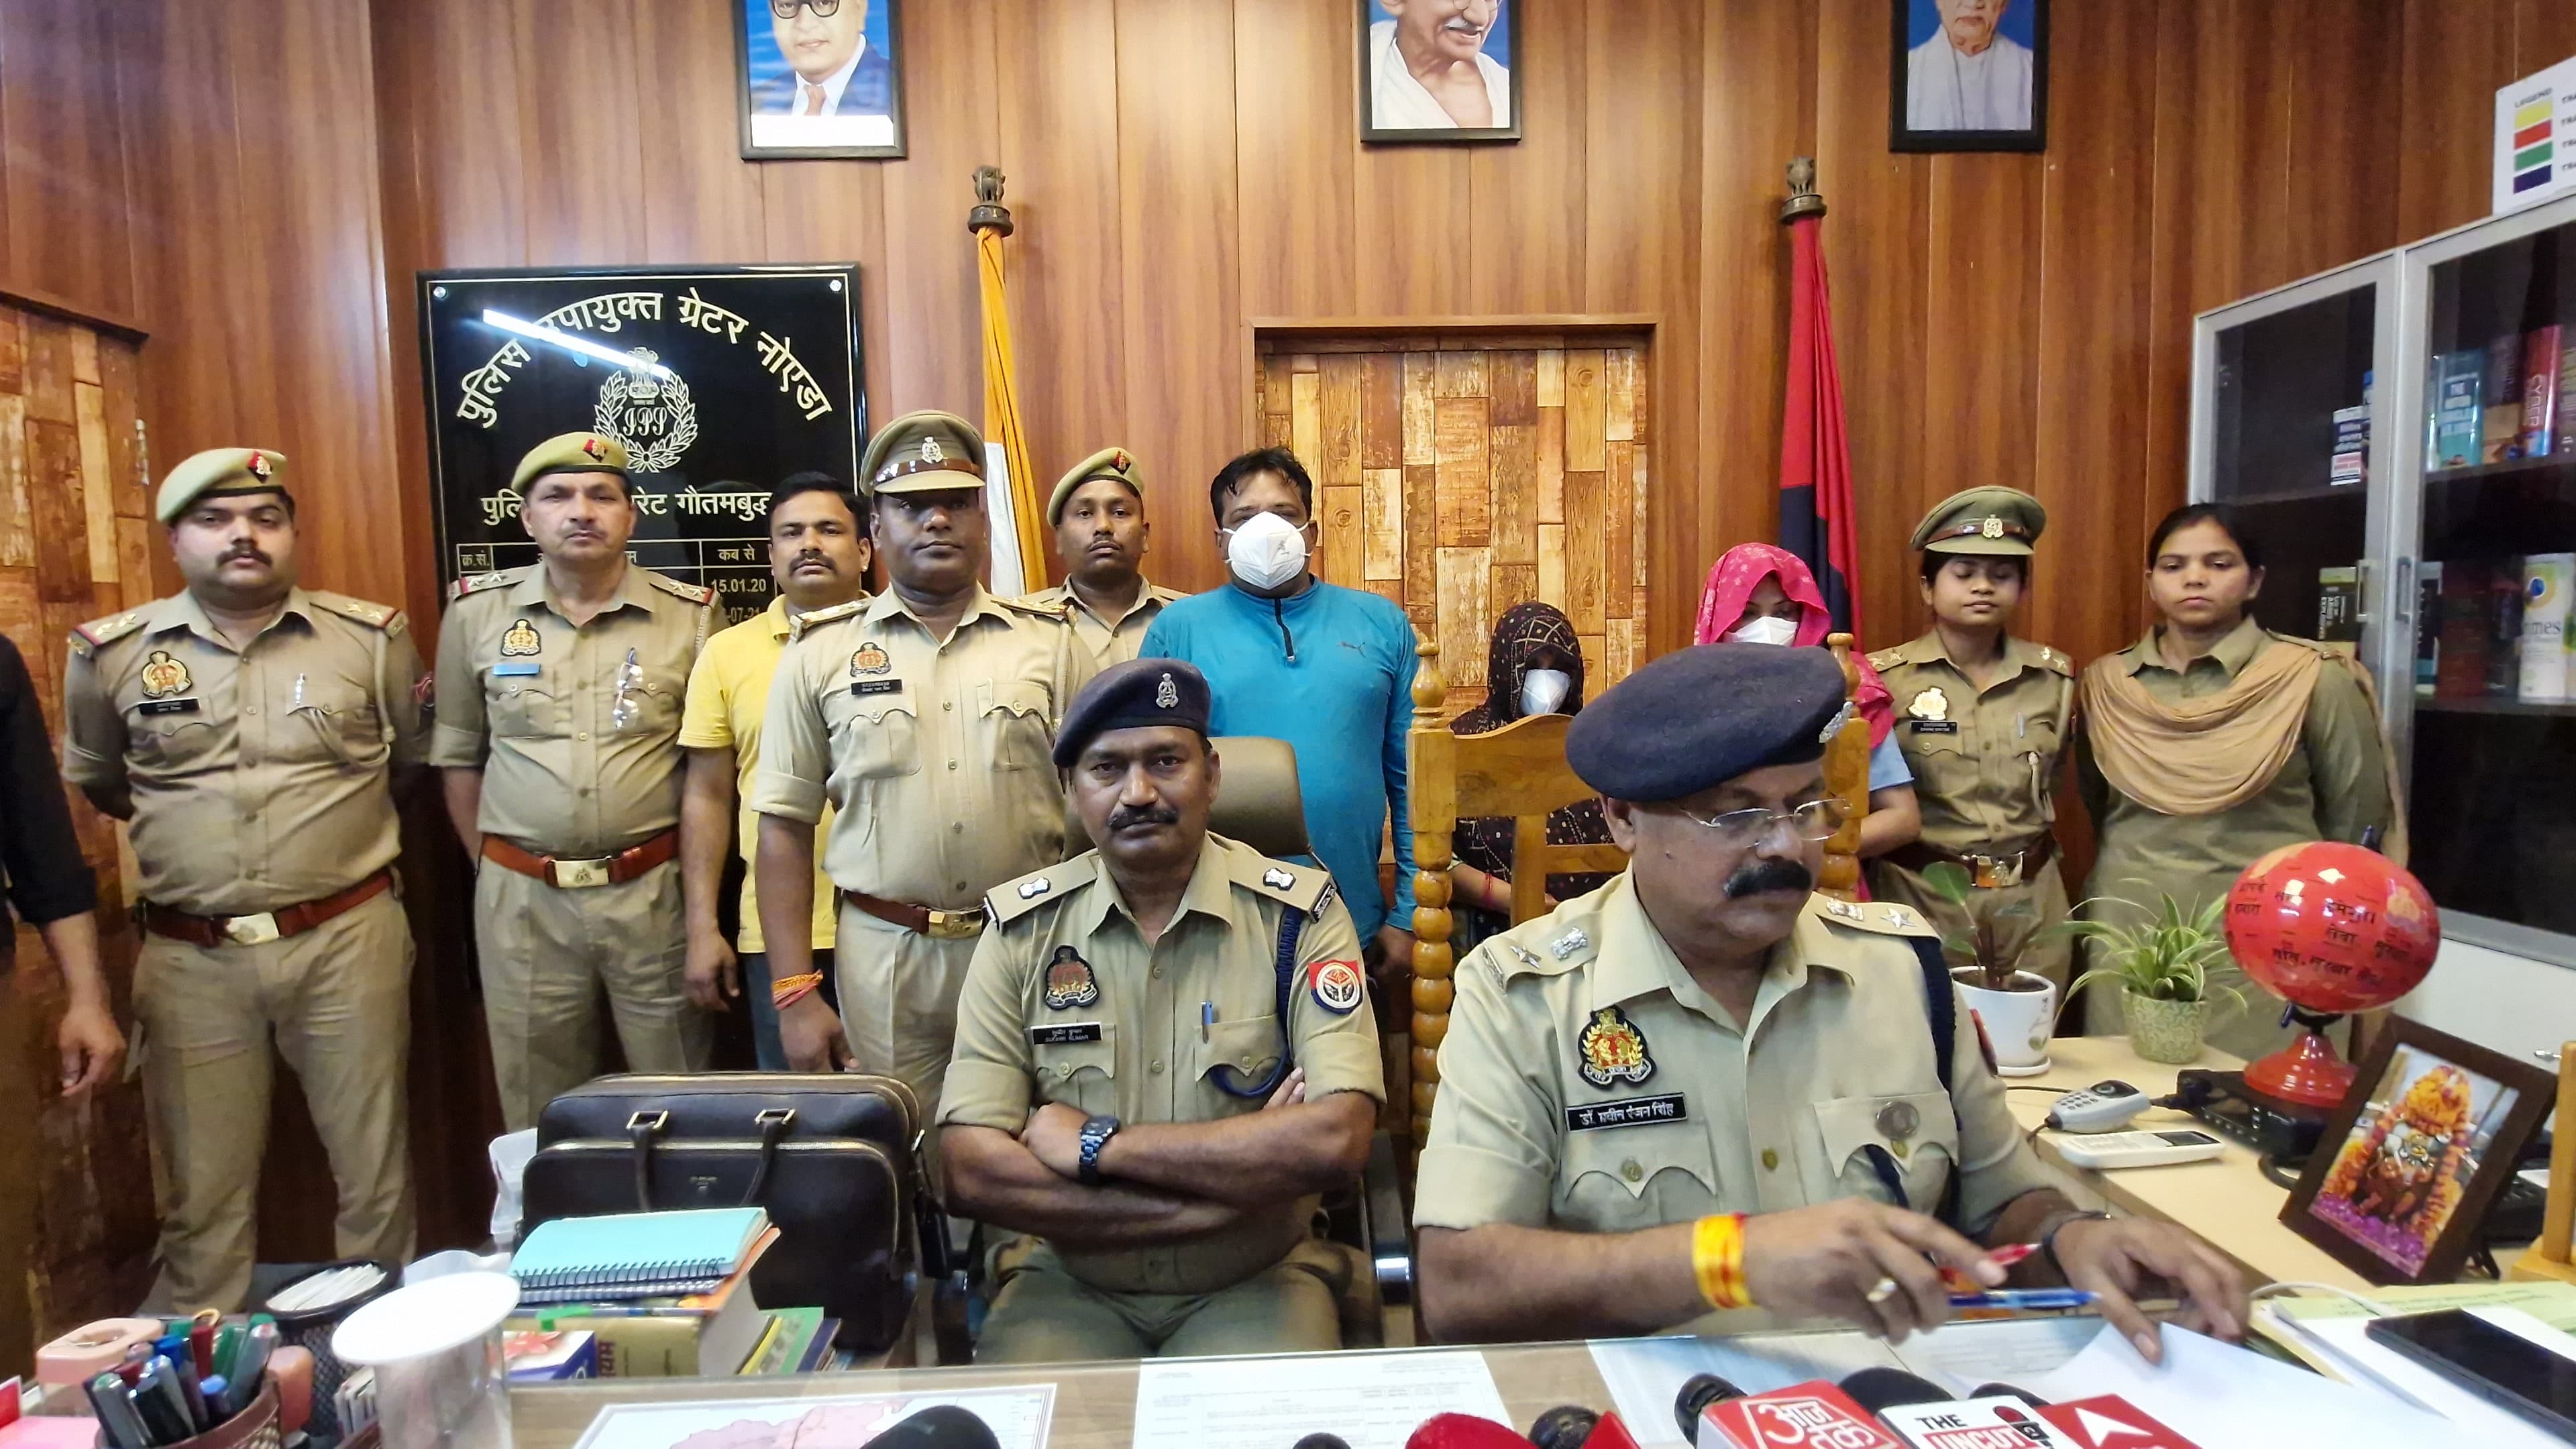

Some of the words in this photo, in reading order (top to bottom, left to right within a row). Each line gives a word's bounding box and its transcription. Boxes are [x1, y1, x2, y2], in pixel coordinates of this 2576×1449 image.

[2516, 87, 2552, 108] LEGEND
[456, 338, 531, 429] पुलिस
[678, 287, 749, 344] ग्रेटर
[757, 331, 833, 421] नोएडा
[480, 488, 525, 526] पुलि
[717, 549, 739, 561] कब
[743, 543, 755, 561] से
[711, 578, 767, 593] 15.01.20
[1758, 1400, 1833, 1444] आज
[1914, 1414, 1968, 1430] THE
[1807, 1418, 1875, 1449] तक
[1929, 1427, 2027, 1449] UNCUT
